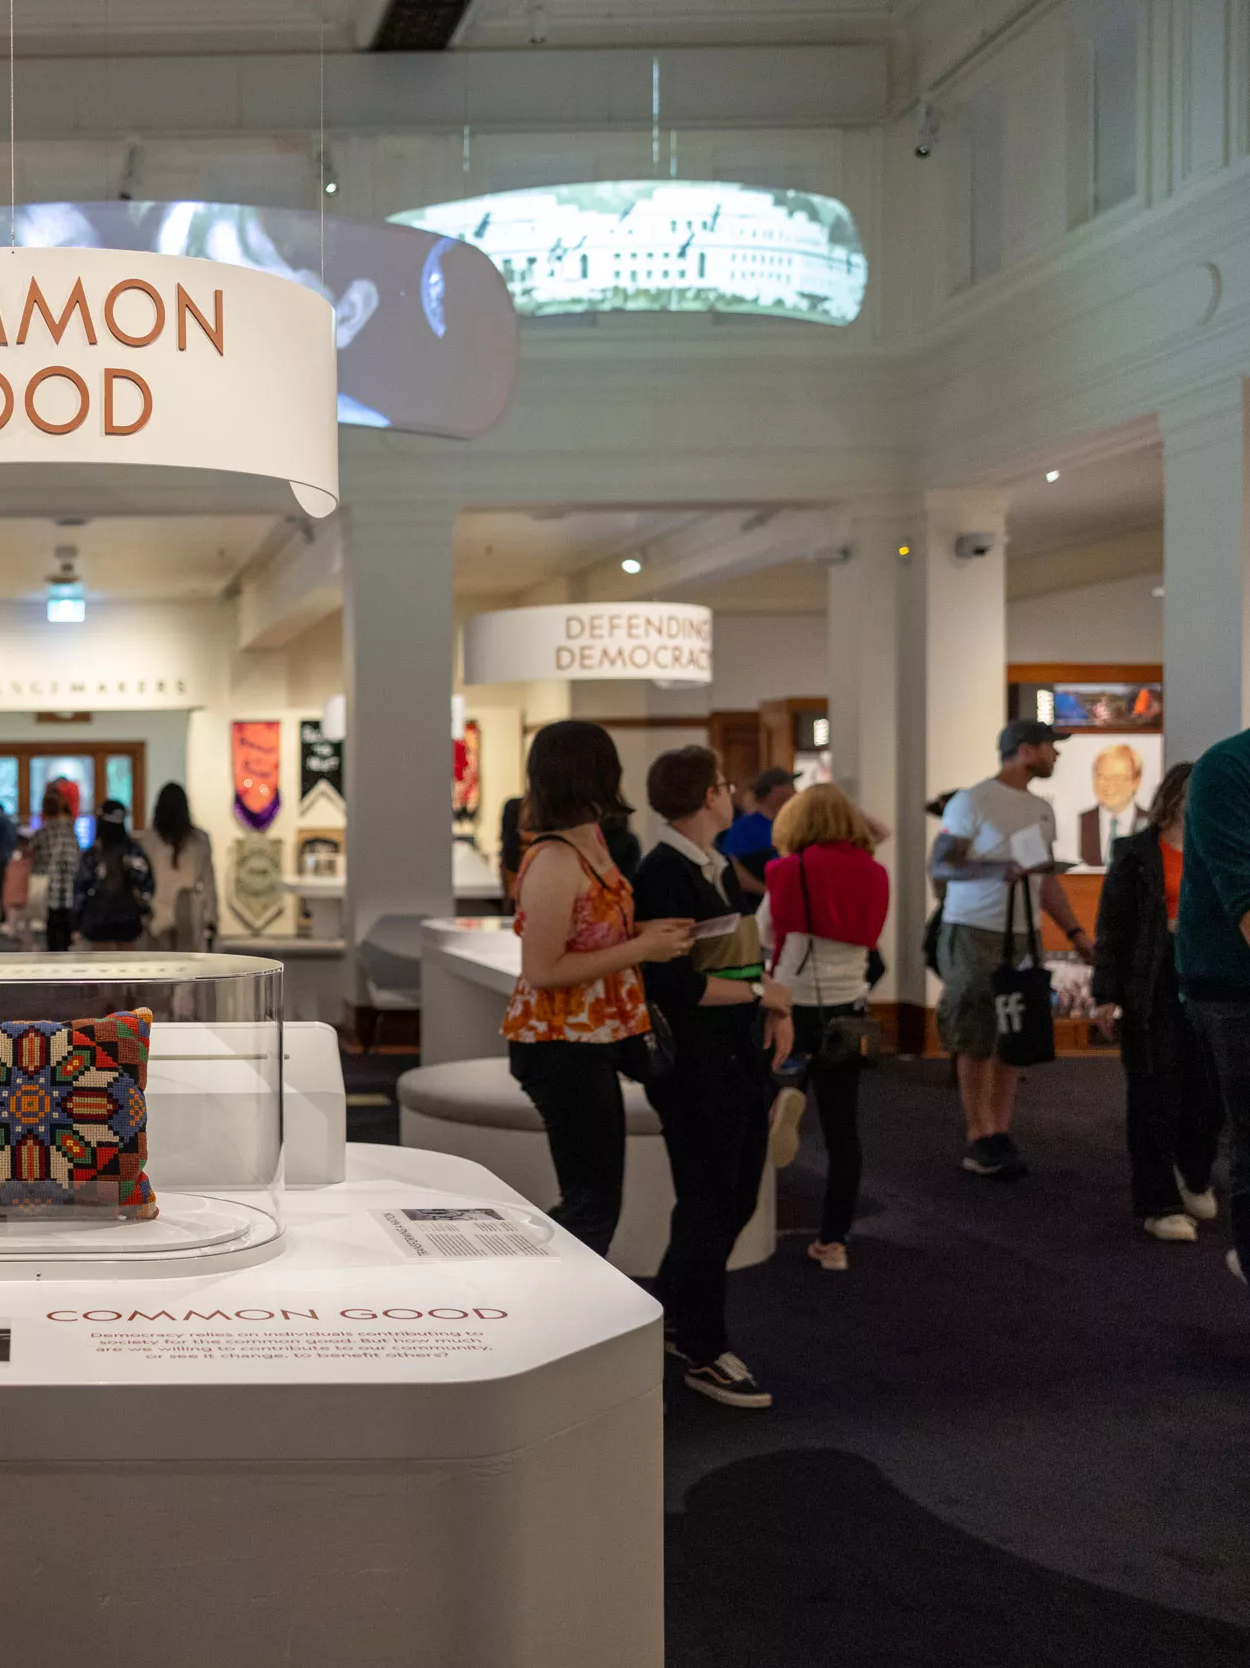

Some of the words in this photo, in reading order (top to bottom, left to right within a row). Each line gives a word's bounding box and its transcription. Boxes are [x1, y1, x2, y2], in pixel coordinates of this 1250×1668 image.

[555, 646, 710, 671] DEMOCRAC
[46, 1309, 320, 1321] COMMON
[339, 1308, 508, 1320] GOOD
